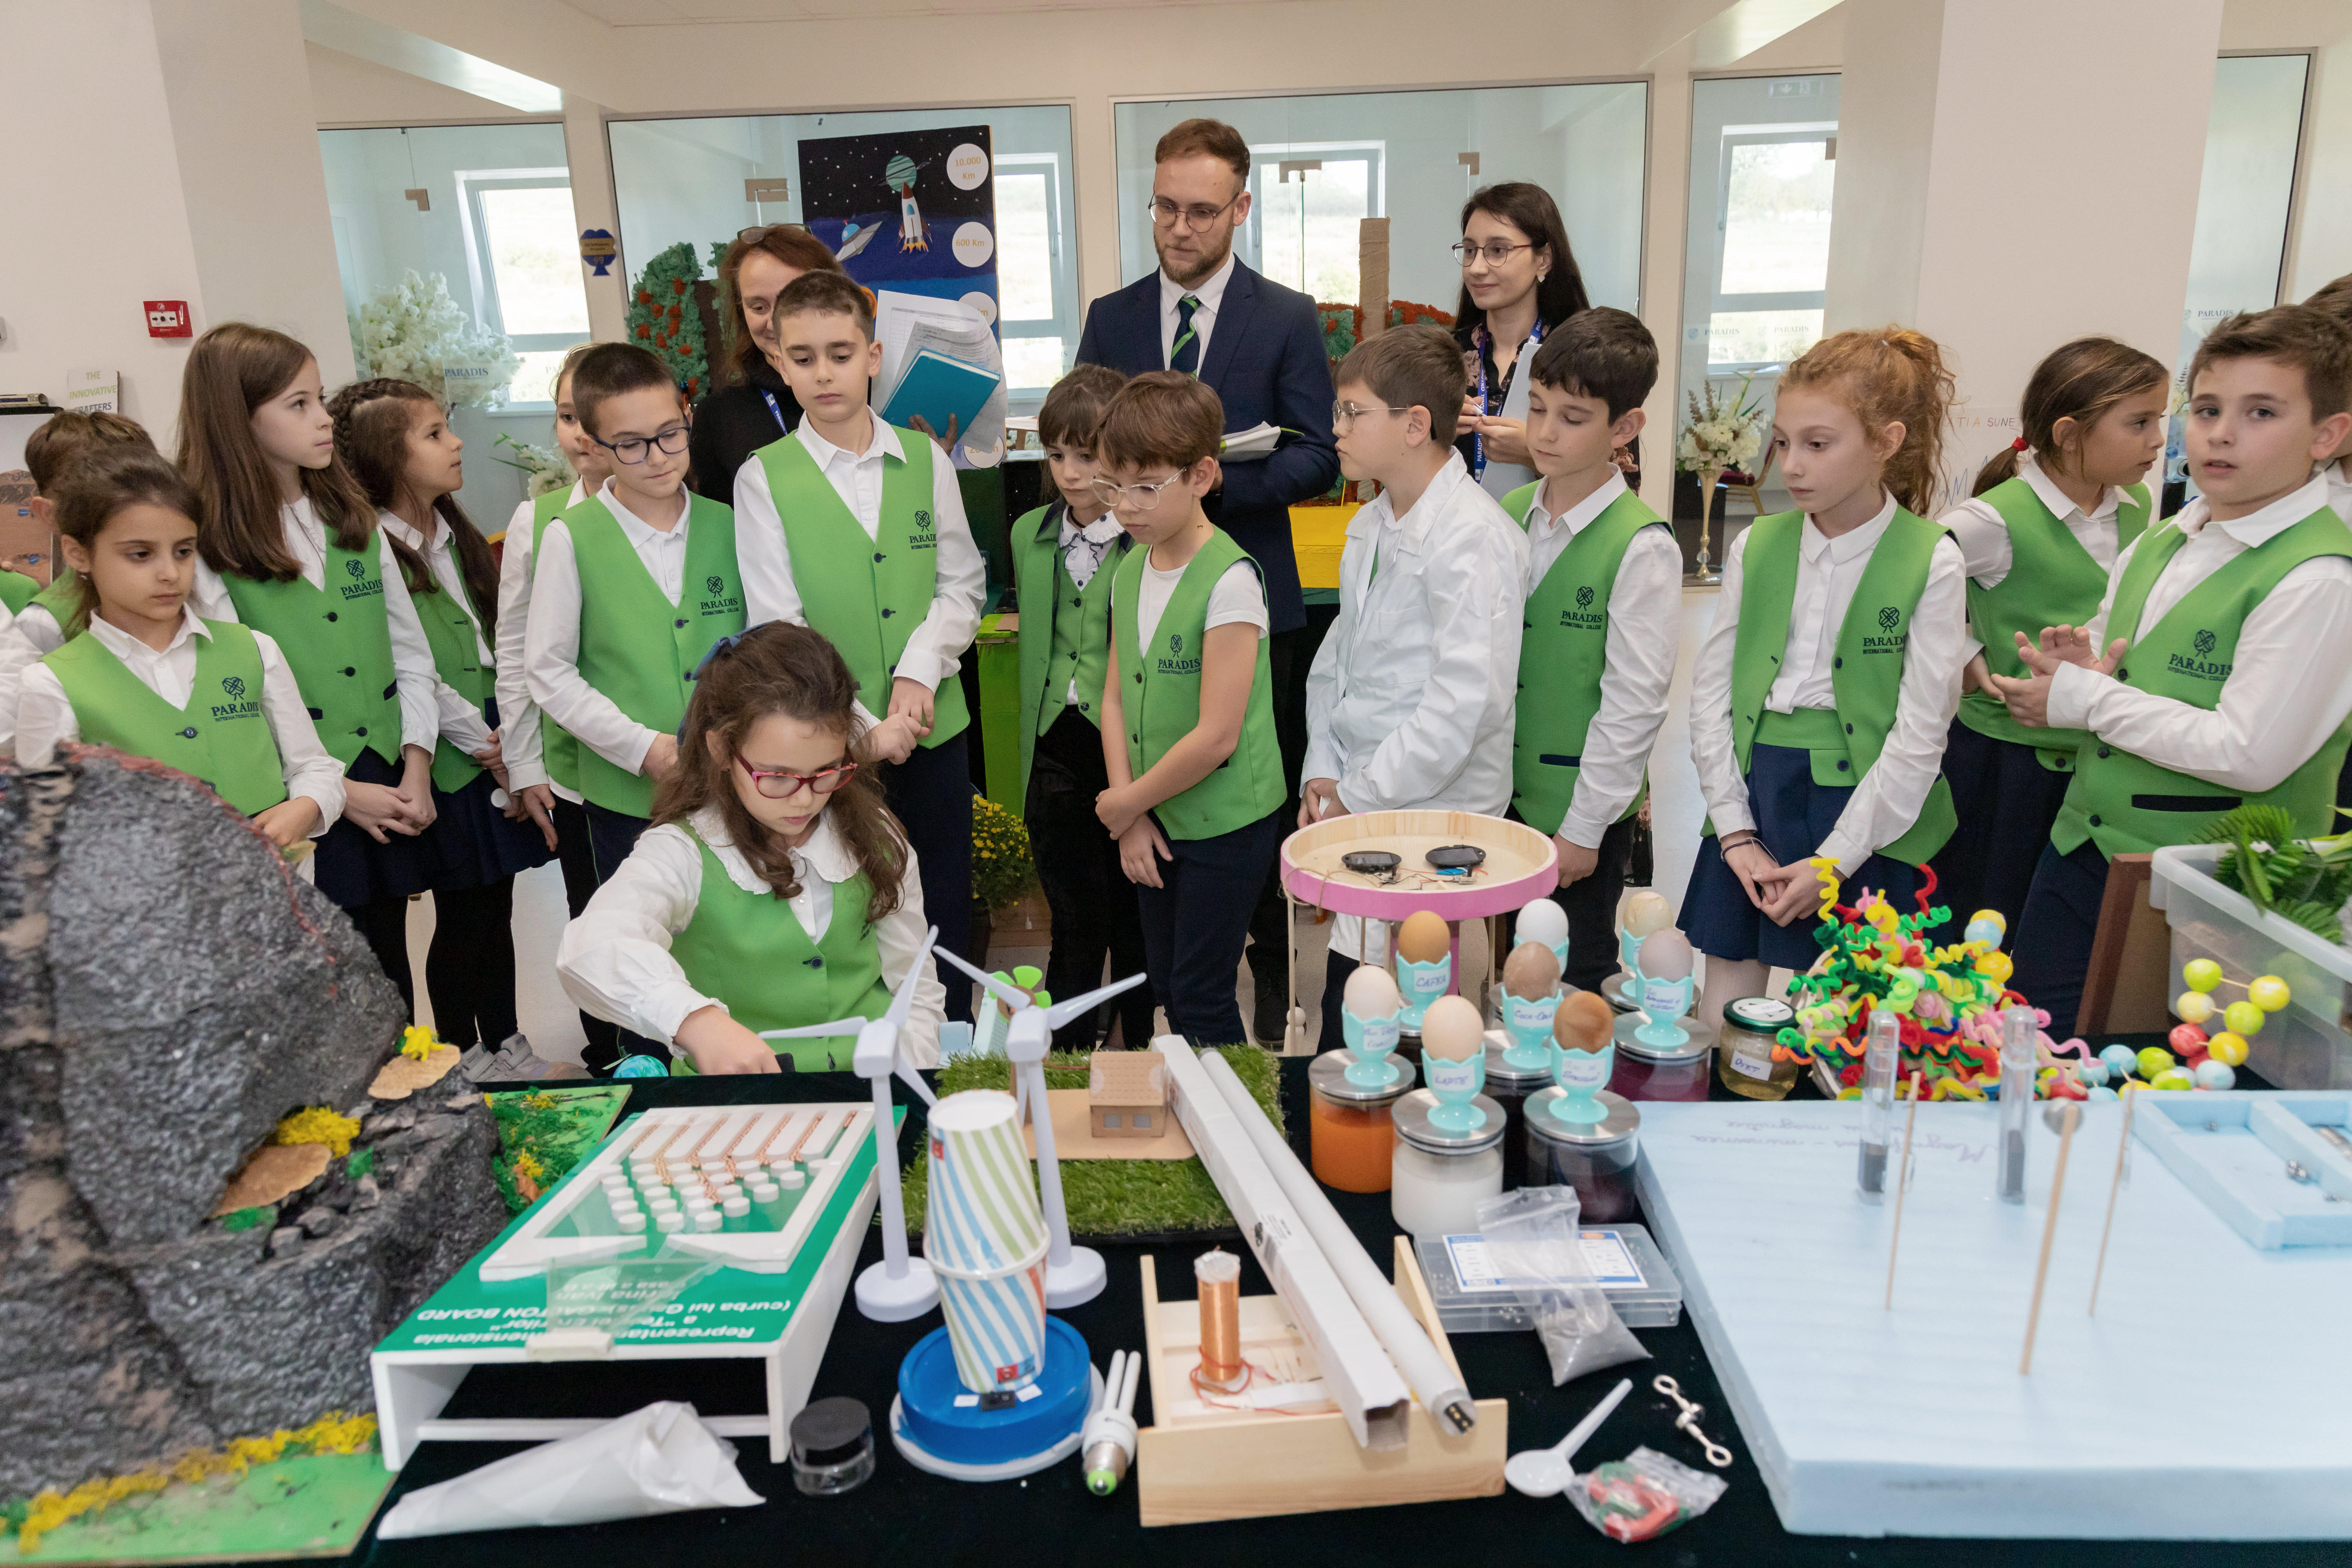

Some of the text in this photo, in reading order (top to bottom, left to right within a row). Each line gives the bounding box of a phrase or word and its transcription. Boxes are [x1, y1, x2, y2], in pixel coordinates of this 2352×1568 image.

[955, 157, 981, 166] 10.000
[1705, 328, 1740, 336] PARADIS
[86, 371, 101, 381] THE
[444, 368, 488, 377] PARADIS
[69, 385, 117, 400] INNOVATIVE
[1987, 417, 2016, 427] SUNE
[909, 533, 936, 543] PARADI
[340, 579, 383, 596] PARADIS
[345, 591, 371, 600] INTERNATIONAL
[700, 598, 738, 609] PARADIS
[1562, 611, 1603, 623] PARADIS
[1560, 621, 1584, 629] INTERNATIONAL
[1863, 636, 1906, 646] PARADI
[1157, 658, 1201, 670] PARADIS
[211, 702, 259, 717] PARADIS
[688, 1302, 715, 1314] lui
[719, 1299, 791, 1314] (curba
[417, 1307, 501, 1321] BOARD
